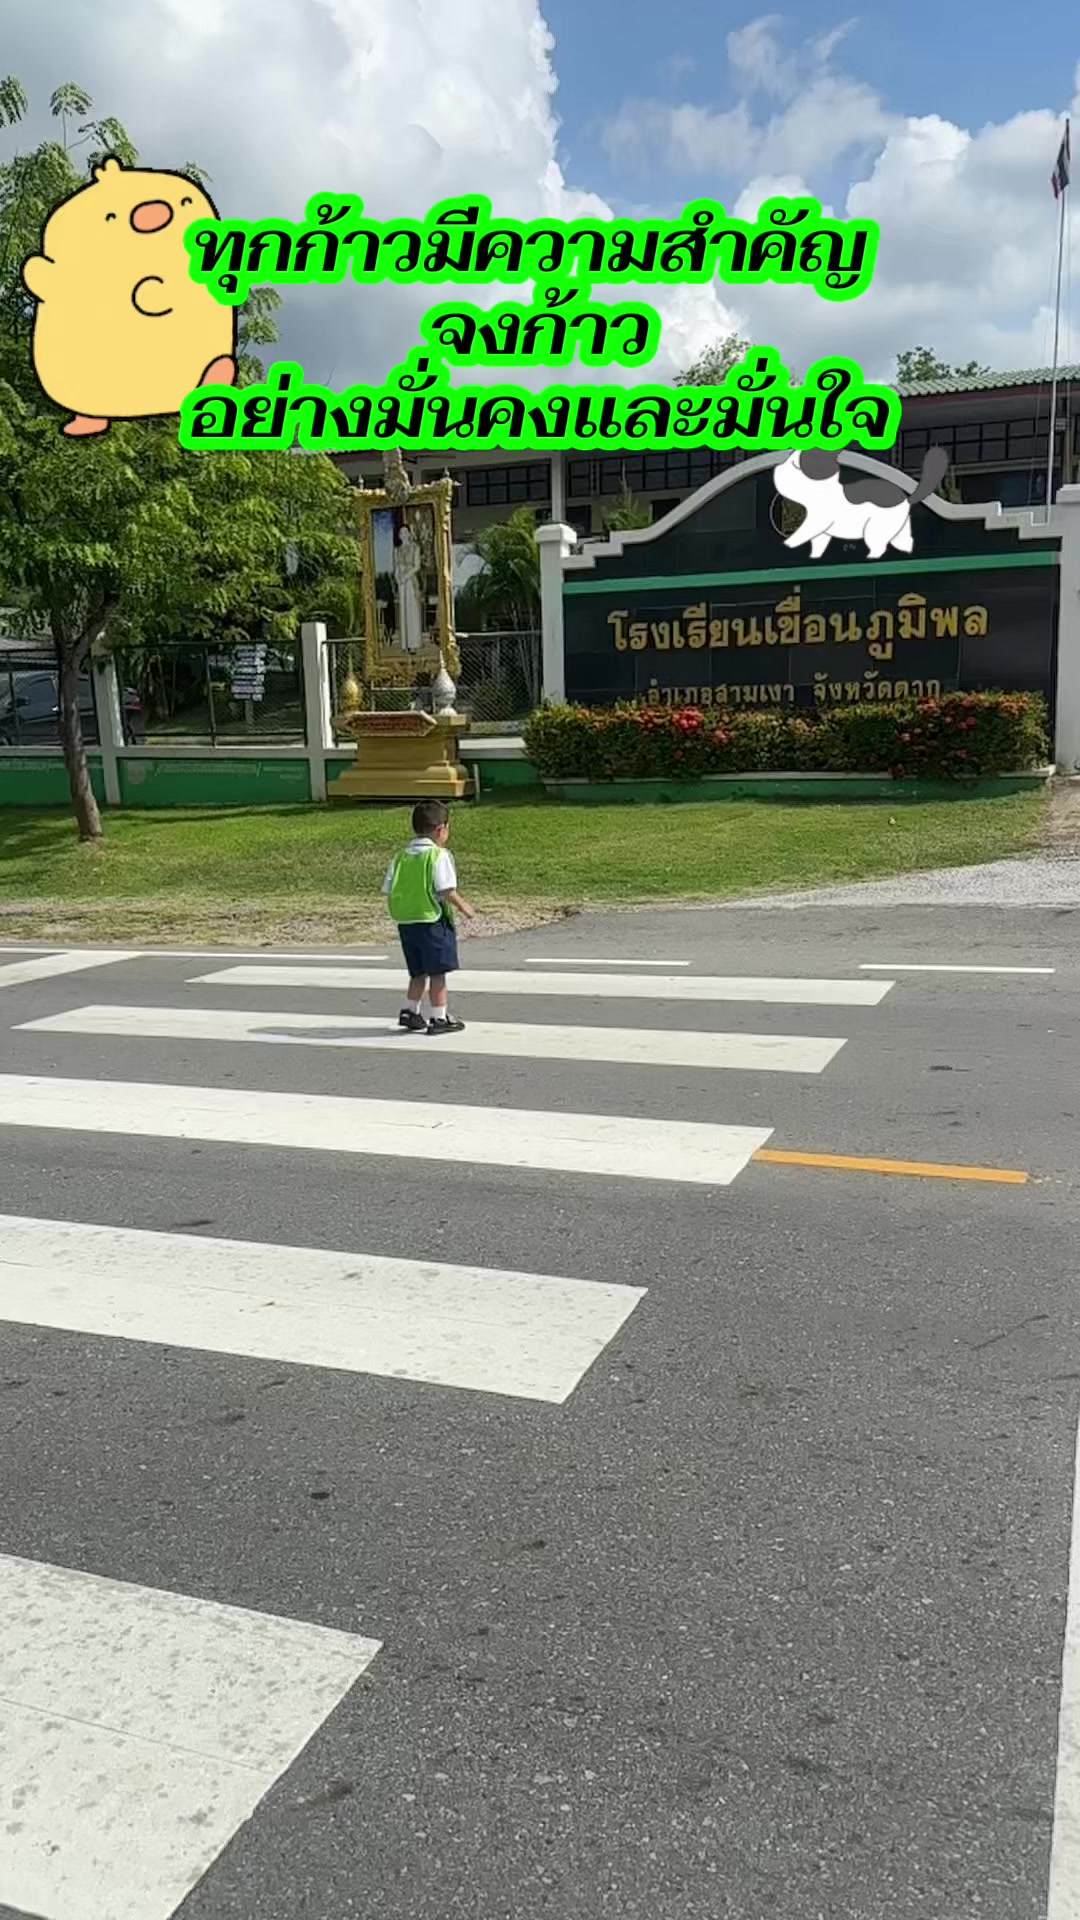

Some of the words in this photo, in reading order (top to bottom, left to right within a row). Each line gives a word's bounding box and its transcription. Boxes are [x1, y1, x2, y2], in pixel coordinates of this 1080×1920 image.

[607, 586, 989, 660] โรงเรียนเขื่อนภูมิพล
